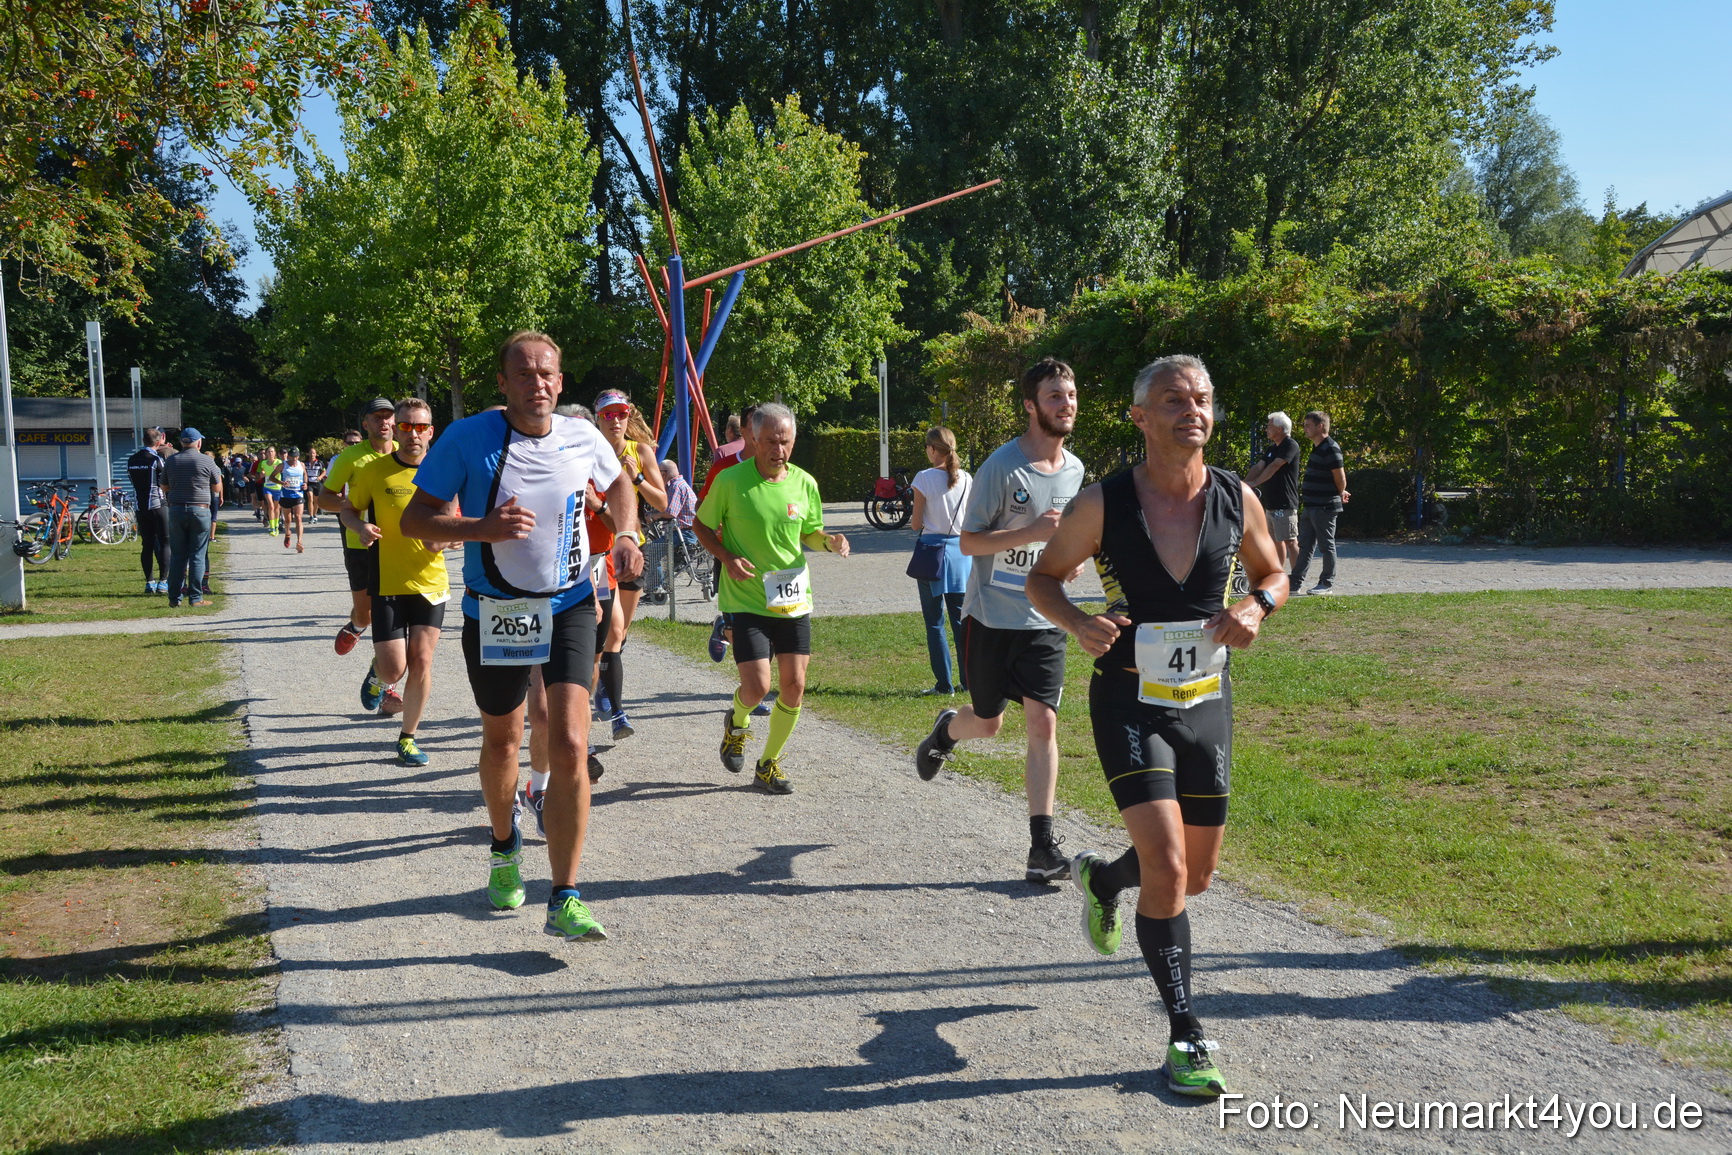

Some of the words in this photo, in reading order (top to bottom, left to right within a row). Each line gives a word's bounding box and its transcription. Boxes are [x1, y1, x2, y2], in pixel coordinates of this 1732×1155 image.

[18, 433, 48, 443] CAFE
[54, 433, 87, 443] KIOSK
[567, 489, 585, 582] HUBER
[560, 511, 573, 584] TECHNOLOGY
[776, 582, 800, 598] 164
[491, 613, 542, 636] 2654
[1164, 630, 1203, 640] BOCK
[502, 647, 534, 658] Werner
[1168, 646, 1196, 673] 41
[1172, 688, 1197, 699] Rene
[1159, 945, 1189, 1014] kalenji
